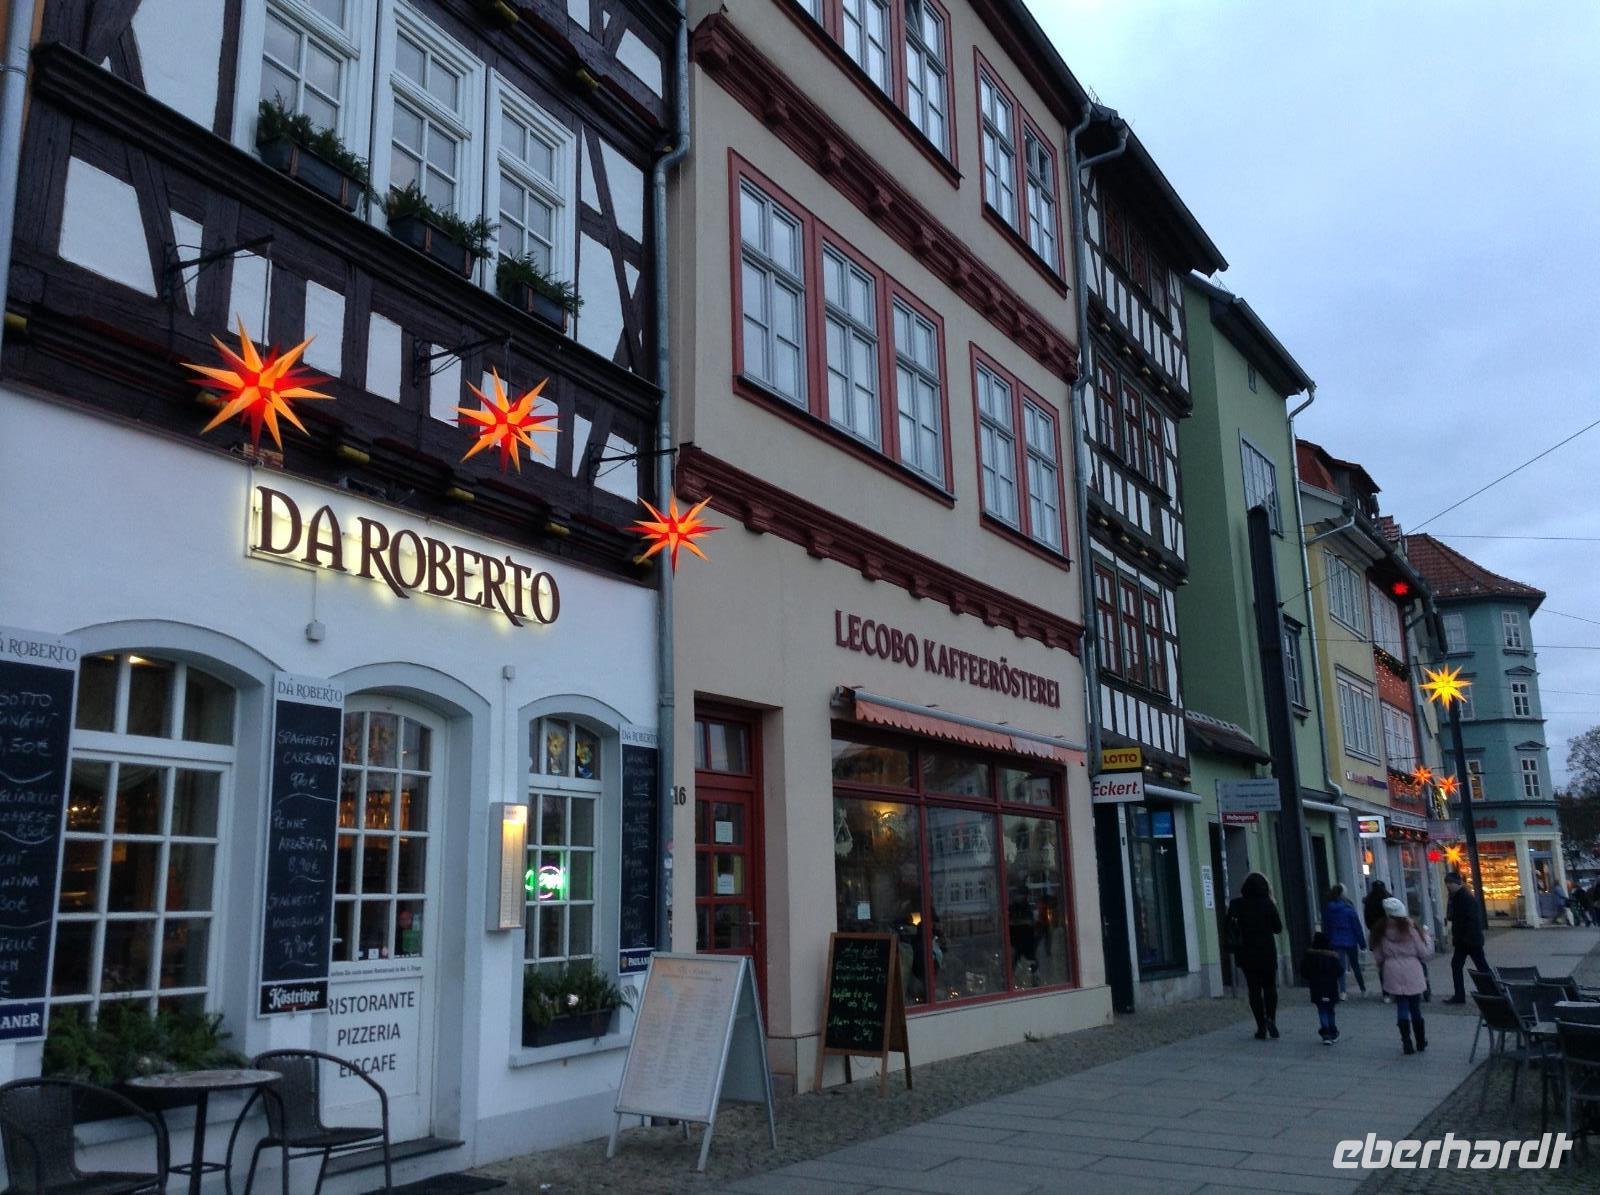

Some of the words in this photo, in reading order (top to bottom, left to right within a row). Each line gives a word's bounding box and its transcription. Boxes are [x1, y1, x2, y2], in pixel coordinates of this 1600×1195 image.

[256, 486, 347, 571] DA
[357, 516, 560, 627] ROBERTO
[8, 637, 77, 664] ROBERTO
[835, 609, 919, 668] LECOBO
[924, 638, 1060, 709] KAFFEERÖSTEREI
[296, 684, 343, 703] ROBERTO
[1104, 753, 1137, 764] LOTTO
[673, 786, 687, 805] 16
[1092, 780, 1141, 797] Eckert.
[328, 991, 415, 1015] RISTORANTE
[337, 1022, 400, 1046] PIZZERIA
